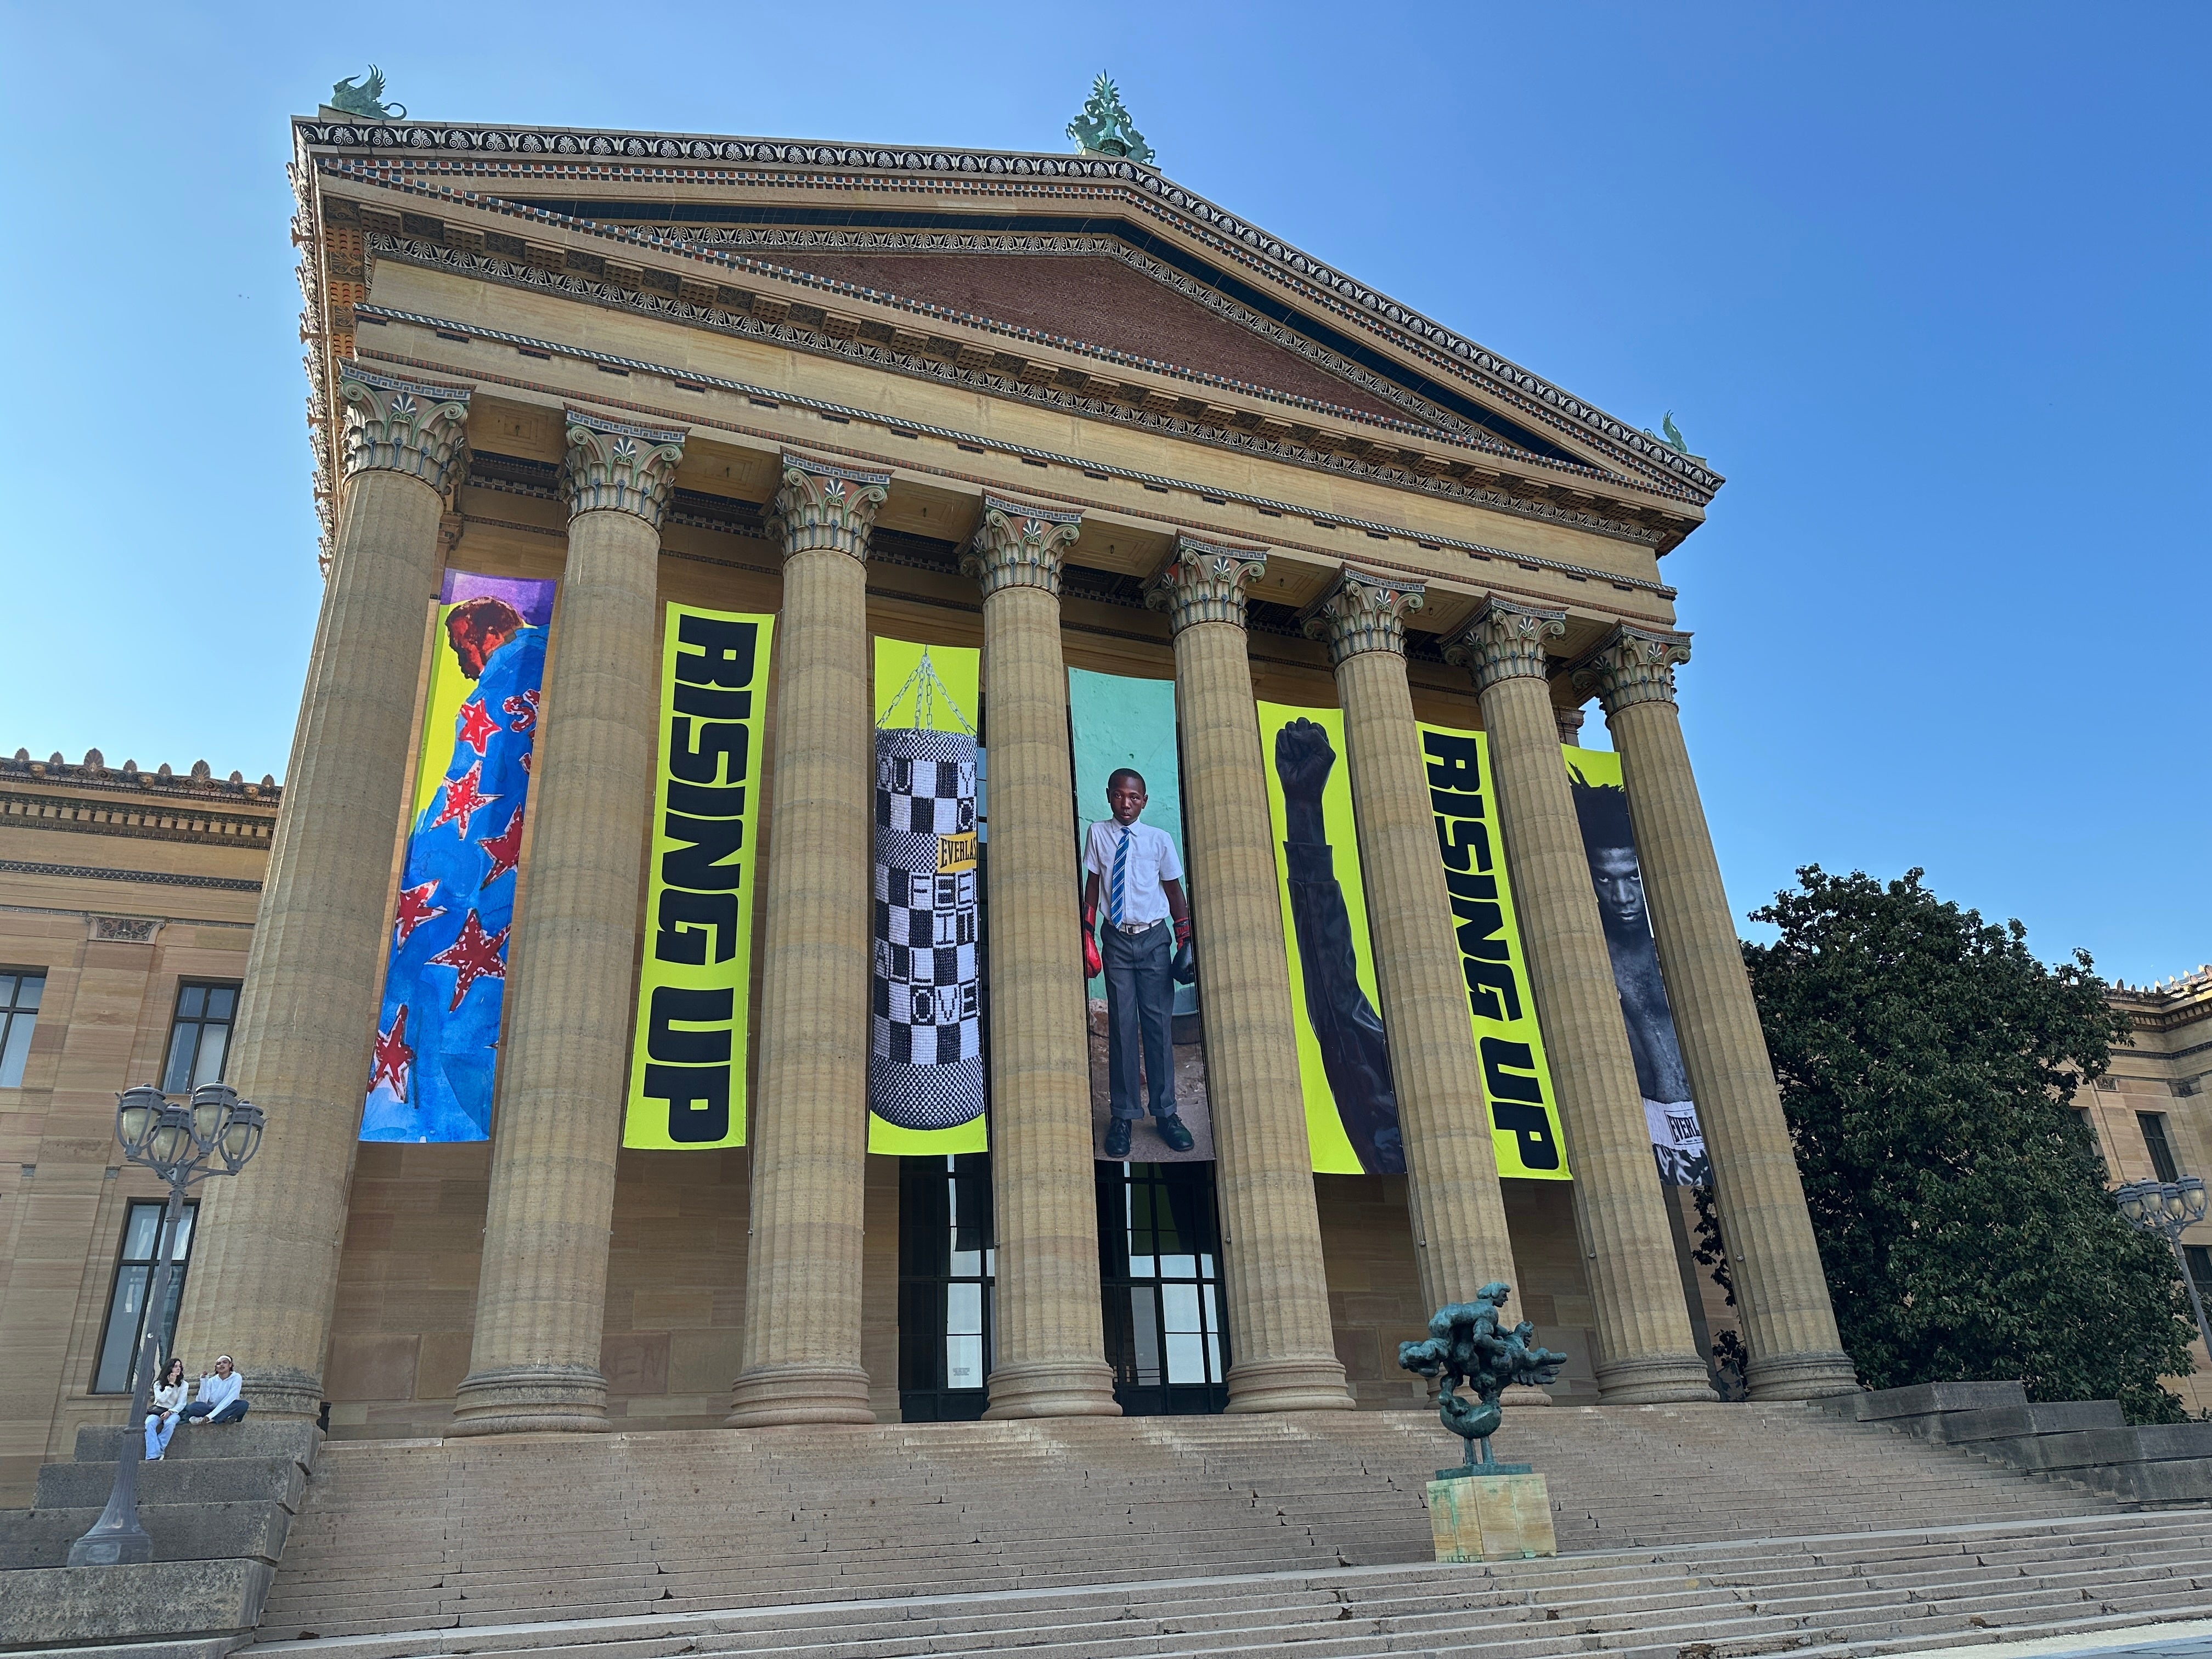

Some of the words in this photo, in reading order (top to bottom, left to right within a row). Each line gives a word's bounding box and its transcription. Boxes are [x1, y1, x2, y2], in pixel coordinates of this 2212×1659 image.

[656, 614, 758, 966] RISING
[935, 909, 973, 945] IT
[875, 941, 932, 983] ALL
[1423, 731, 1522, 1022] RISING
[1480, 1036, 1559, 1170] UP
[912, 981, 980, 1023] OVE
[644, 986, 733, 1143] UP
[1666, 1114, 1702, 1143] EVERL
